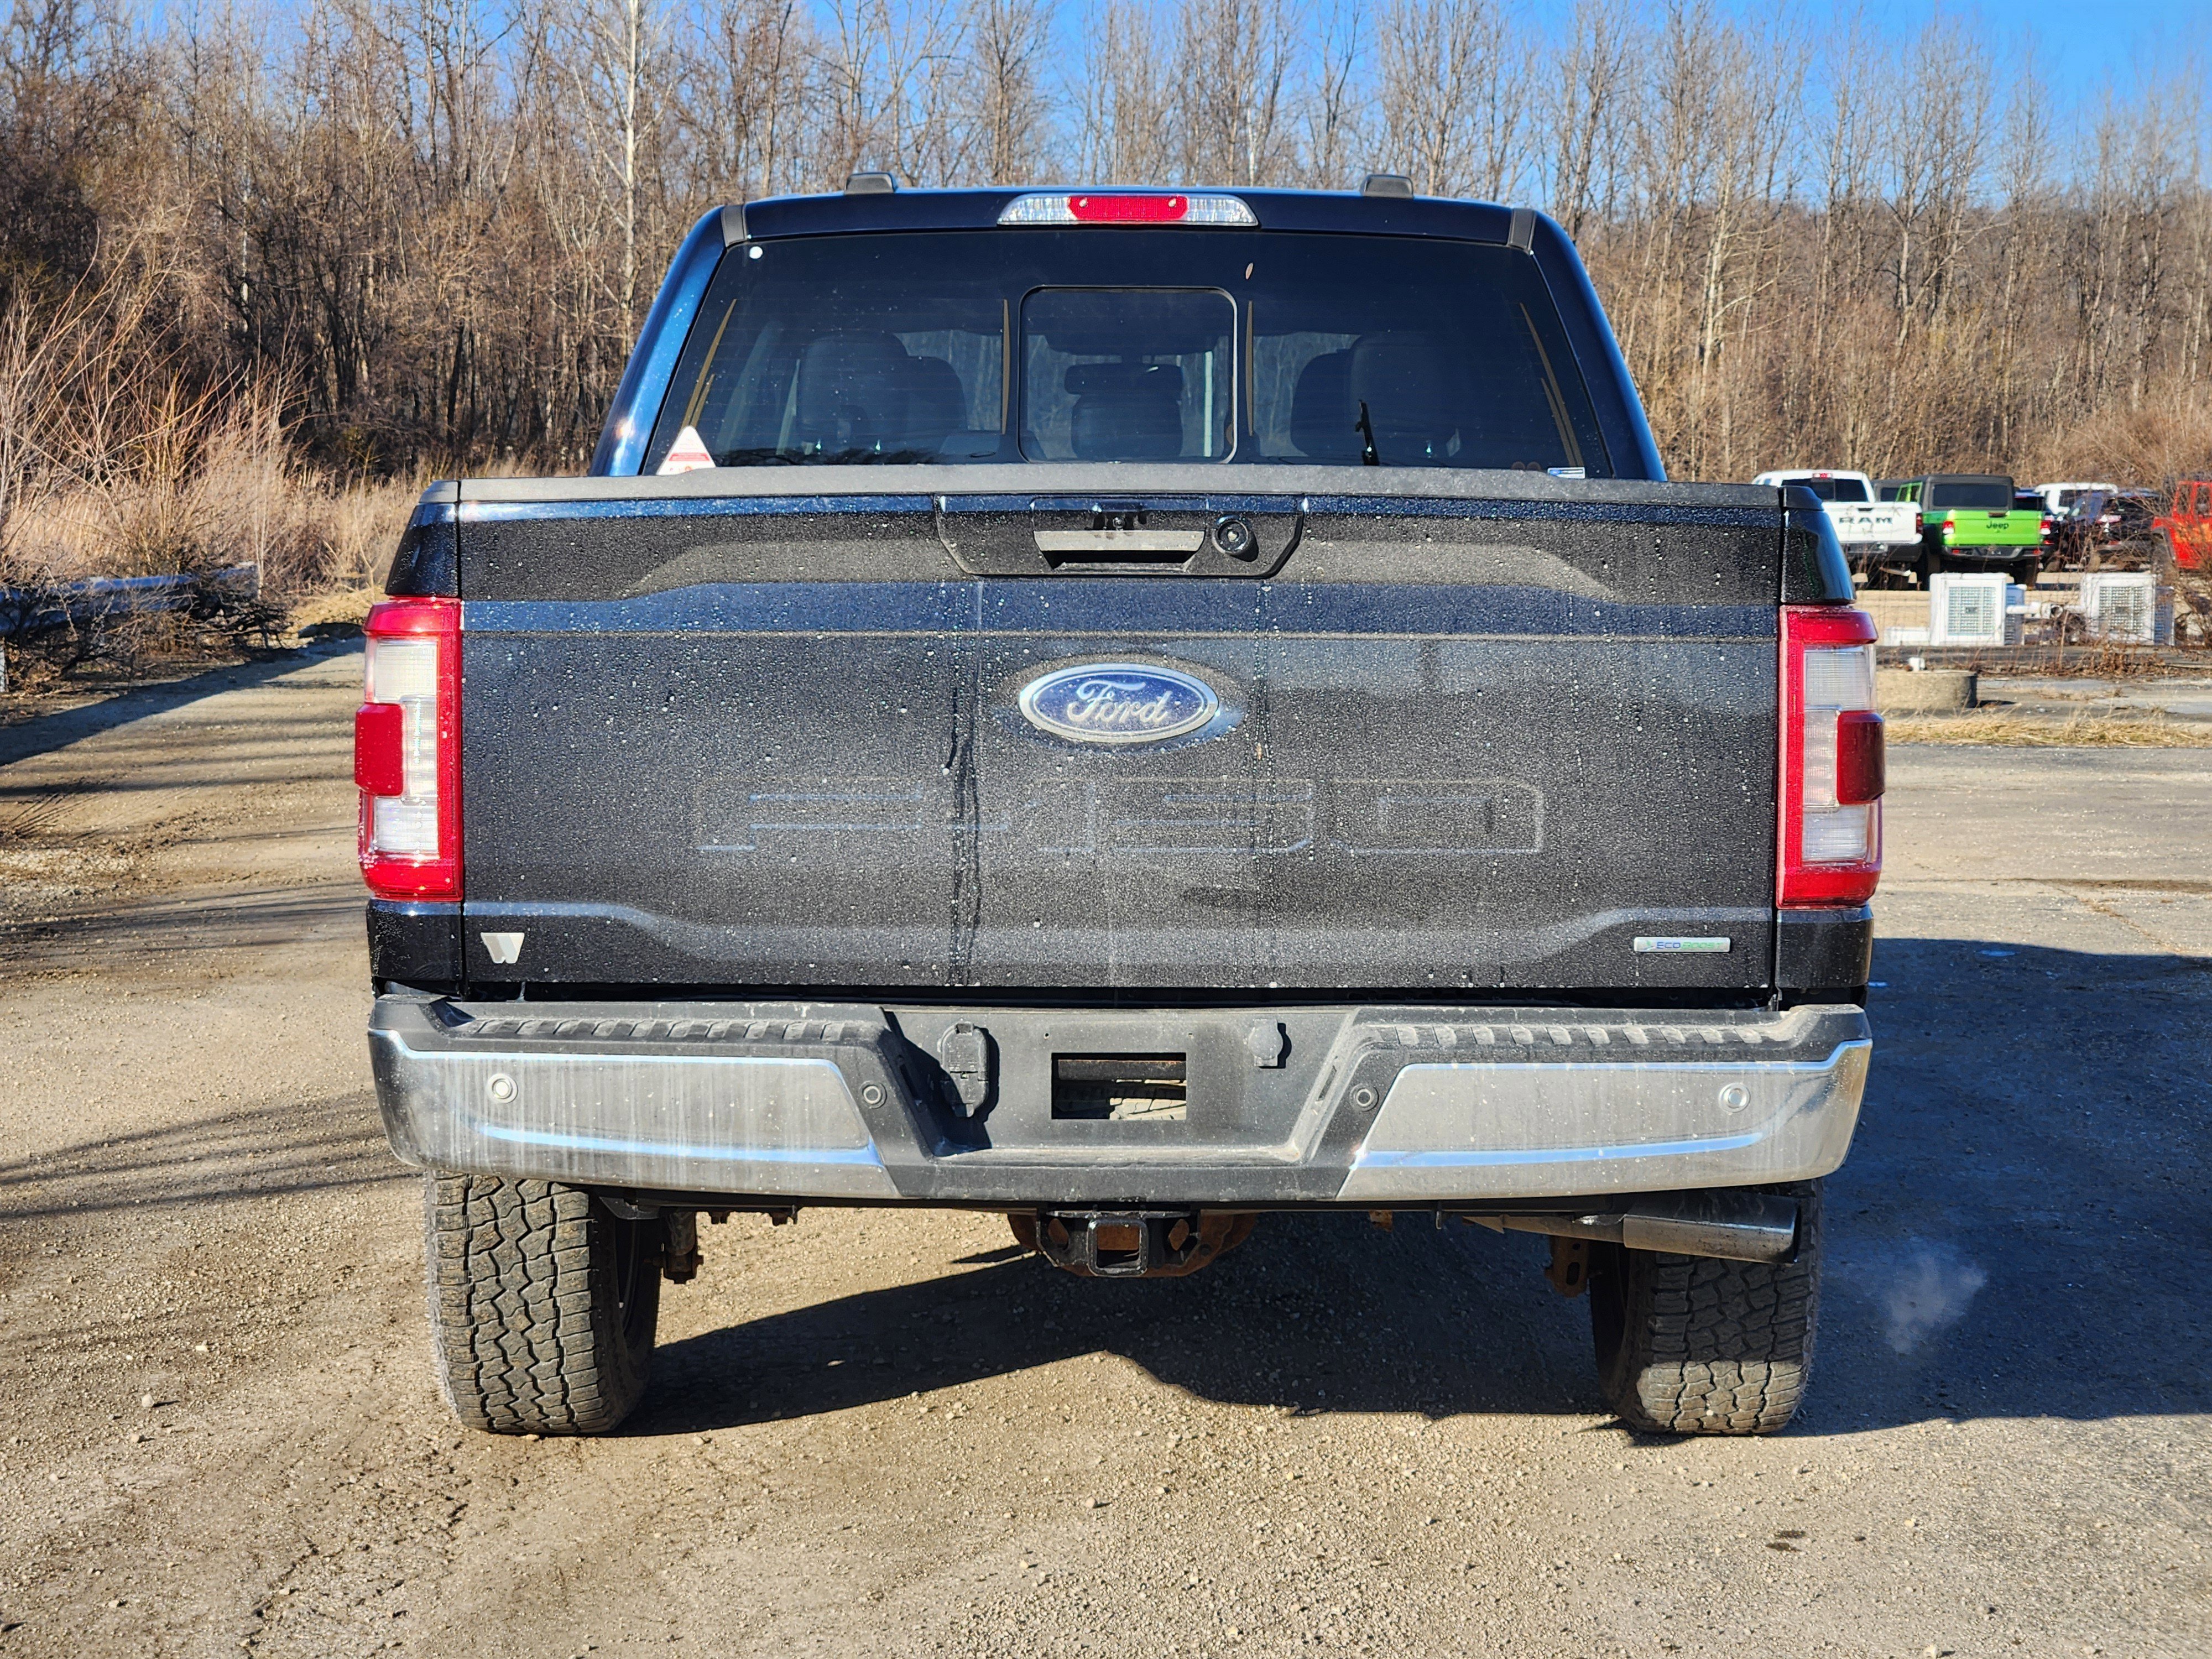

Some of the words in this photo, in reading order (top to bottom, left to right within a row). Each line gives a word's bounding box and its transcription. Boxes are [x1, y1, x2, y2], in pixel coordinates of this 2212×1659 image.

[1986, 521, 2010, 529] Jeep
[1066, 679, 1173, 725] Ford
[695, 776, 1545, 854] F-150
